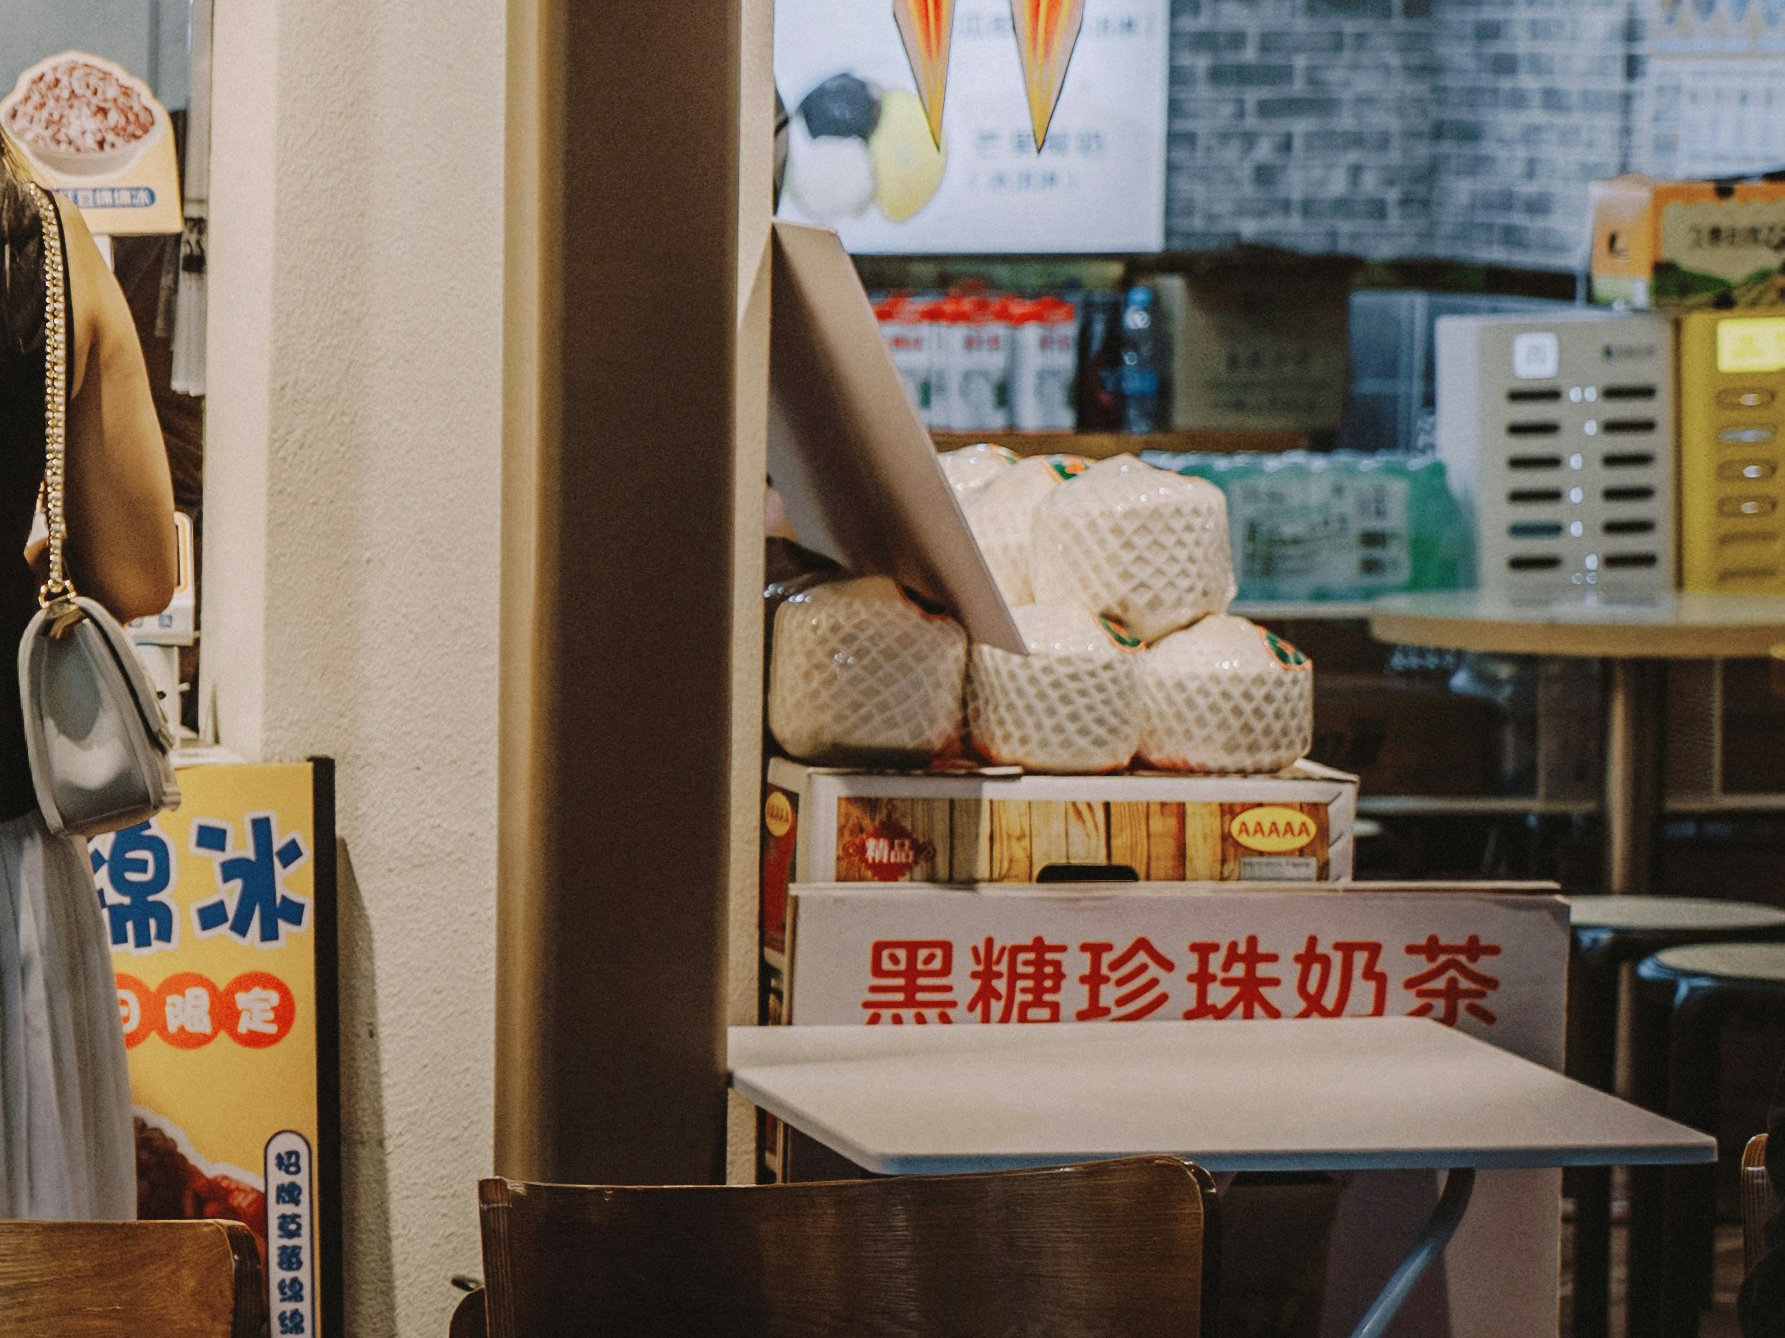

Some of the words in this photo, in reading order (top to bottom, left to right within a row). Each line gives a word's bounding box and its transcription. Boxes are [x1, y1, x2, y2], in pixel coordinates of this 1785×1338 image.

[1237, 821, 1310, 837] AAAAA
[861, 933, 1503, 1028] 黑糖珍珠奶茶
